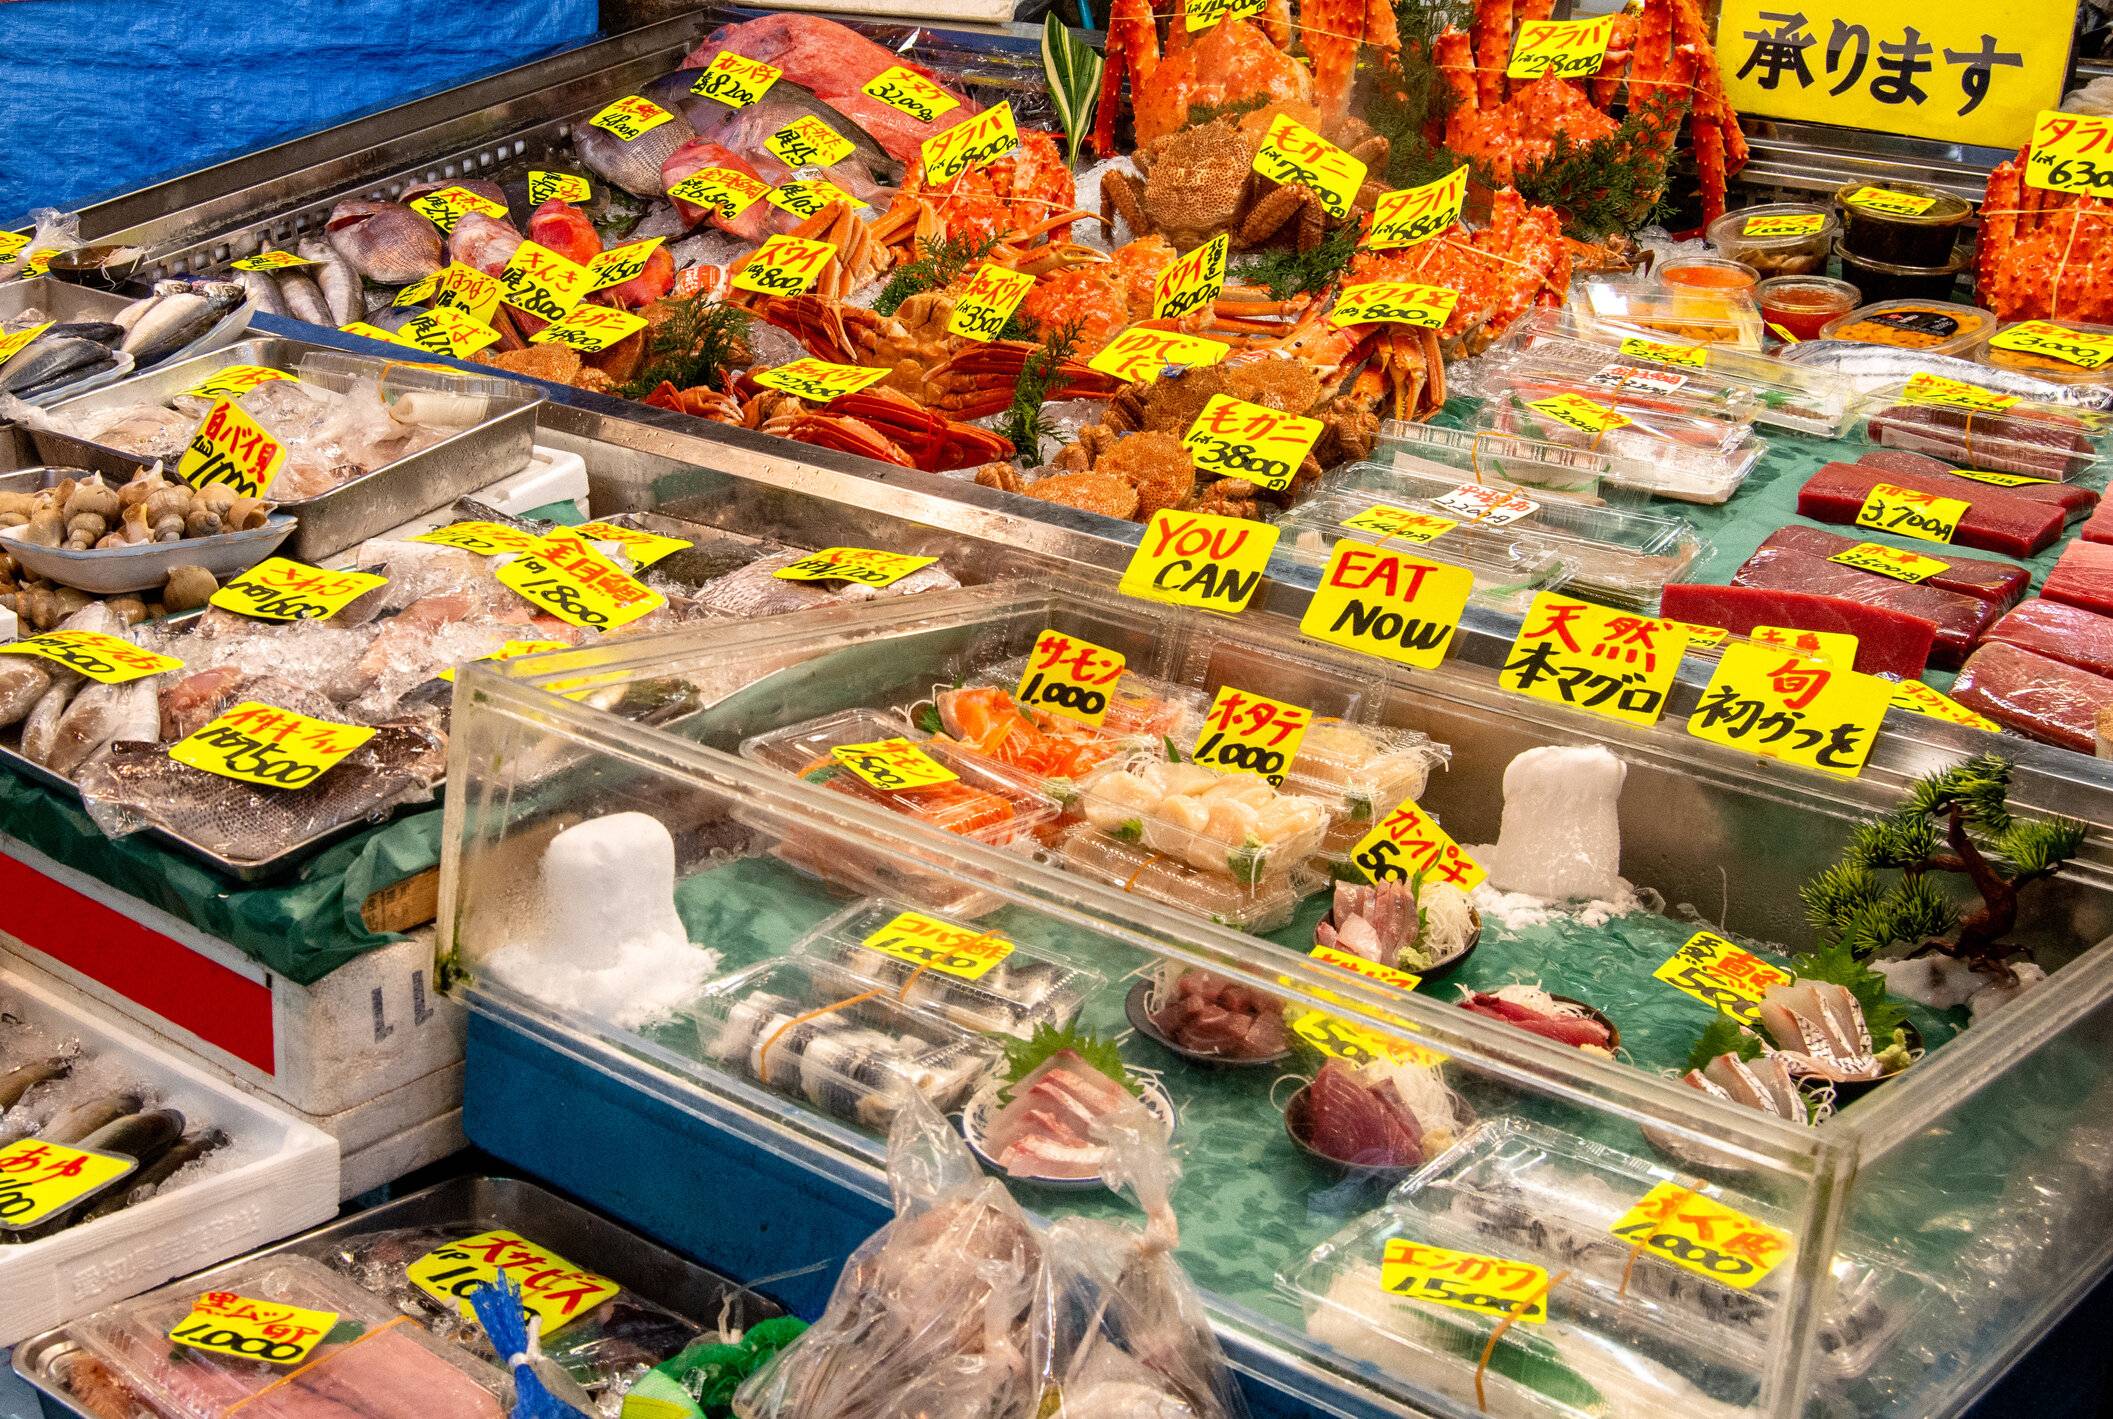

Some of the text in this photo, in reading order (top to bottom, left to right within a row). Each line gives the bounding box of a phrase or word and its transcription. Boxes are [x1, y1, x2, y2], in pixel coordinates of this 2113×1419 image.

[1520, 16, 1613, 51] タラバ
[1736, 11, 2023, 117] 承ります
[928, 103, 1009, 162] タラバ
[1269, 125, 1349, 180] 毛ガニ
[440, 190, 494, 212] 天然た
[1378, 167, 1467, 224] タラバ
[520, 252, 578, 292] きんき
[753, 239, 829, 273] ズワイ
[1156, 246, 1209, 305] ズワイ
[435, 311, 492, 345] さば
[1201, 400, 1309, 445] 毛ガニ
[1152, 517, 1249, 560] YOU
[530, 537, 651, 609] 金目鯛
[1153, 559, 1260, 603] CAN
[1330, 550, 1439, 603] EAT
[1330, 599, 1452, 650] NOW
[1523, 602, 1672, 673] 天然
[1037, 635, 1124, 686] サーモン
[1502, 641, 1663, 714] 本マグロ
[1767, 658, 1832, 711] 旬
[1207, 692, 1304, 747] ホタテ
[1692, 684, 1867, 769] 初かつを
[0, 1146, 89, 1184] あゆ
[1381, 1245, 1538, 1292] エンガワ
